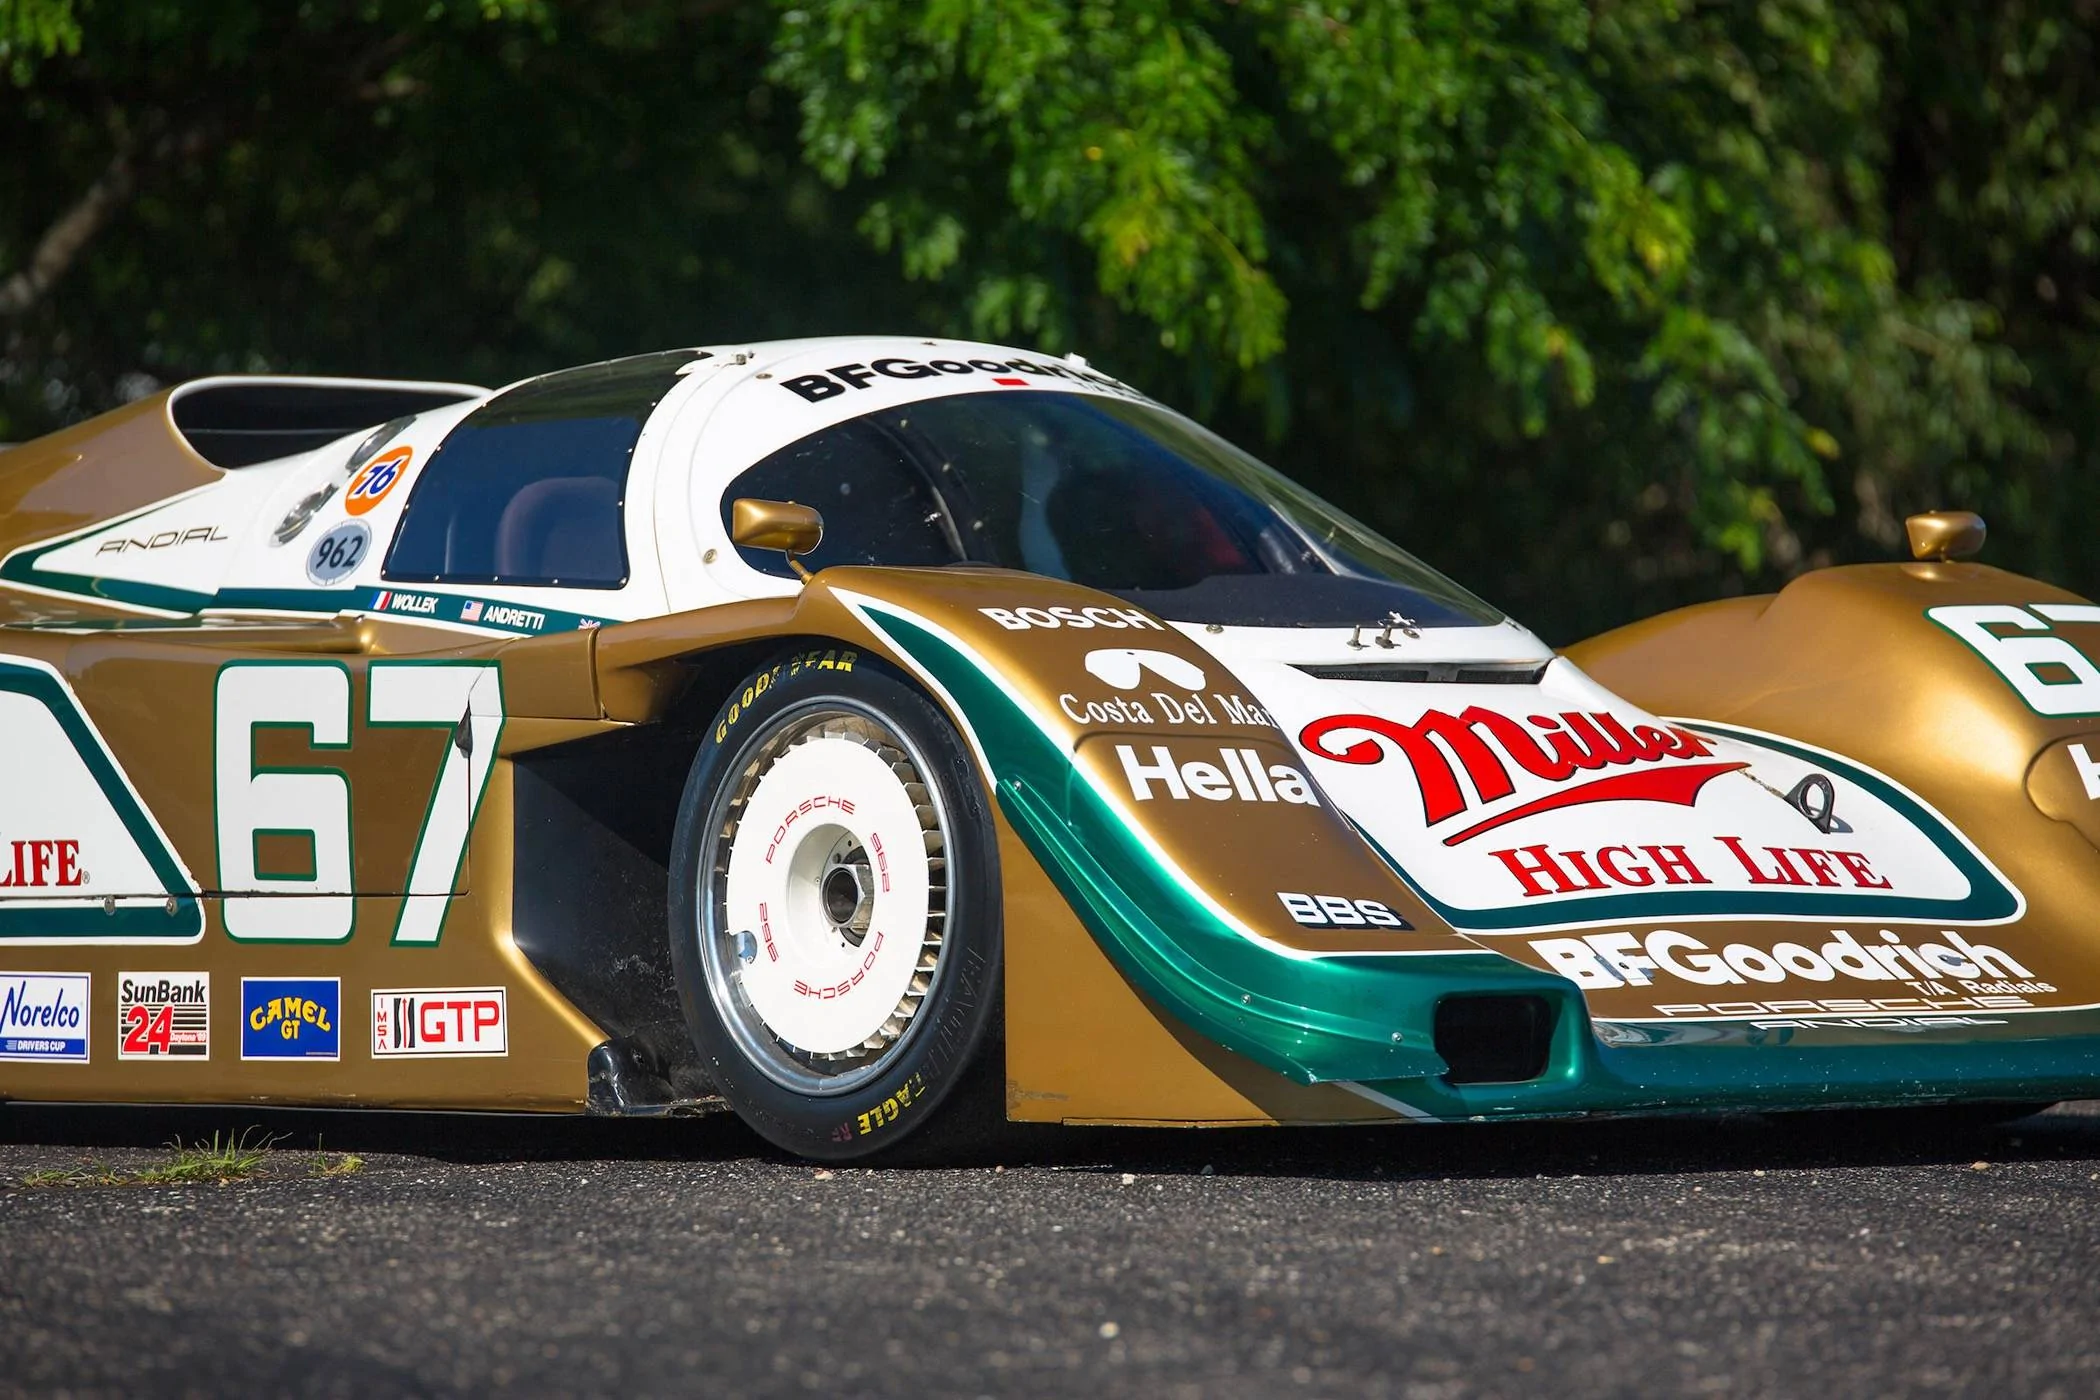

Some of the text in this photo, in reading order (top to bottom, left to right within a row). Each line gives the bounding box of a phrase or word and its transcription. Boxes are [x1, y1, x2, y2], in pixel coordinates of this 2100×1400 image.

[350, 456, 408, 498] 76
[95, 525, 229, 557] ANDIAL
[316, 533, 363, 569] 962
[391, 593, 439, 614] WOLLEK
[483, 605, 546, 631] ANDRETTI
[977, 606, 1166, 631] BOSCH
[1059, 693, 1154, 724] Costa
[1150, 693, 1217, 725] Del
[1115, 745, 1321, 808] Hella
[1298, 705, 1718, 828] Miller
[213, 659, 506, 948] 67
[765, 796, 856, 864] PORSCHE
[869, 832, 891, 893] 962
[1489, 835, 1893, 897] HIGH LIFE
[1277, 892, 1415, 931] BBS
[759, 902, 780, 962] 962
[793, 931, 884, 999] PORSCHE
[1527, 929, 2036, 991] BFGoodrich
[0, 980, 80, 1034] Norelco
[121, 979, 206, 1003] SunBank
[1652, 996, 2035, 1017] PORSCHE
[1905, 980, 2058, 996] T/A Radials
[122, 1004, 174, 1054] 24
[250, 997, 331, 1032] CAMEL
[281, 1020, 301, 1040] GT
[420, 1001, 500, 1043] GTP
[17, 1041, 66, 1052] DRIVERS CUP
